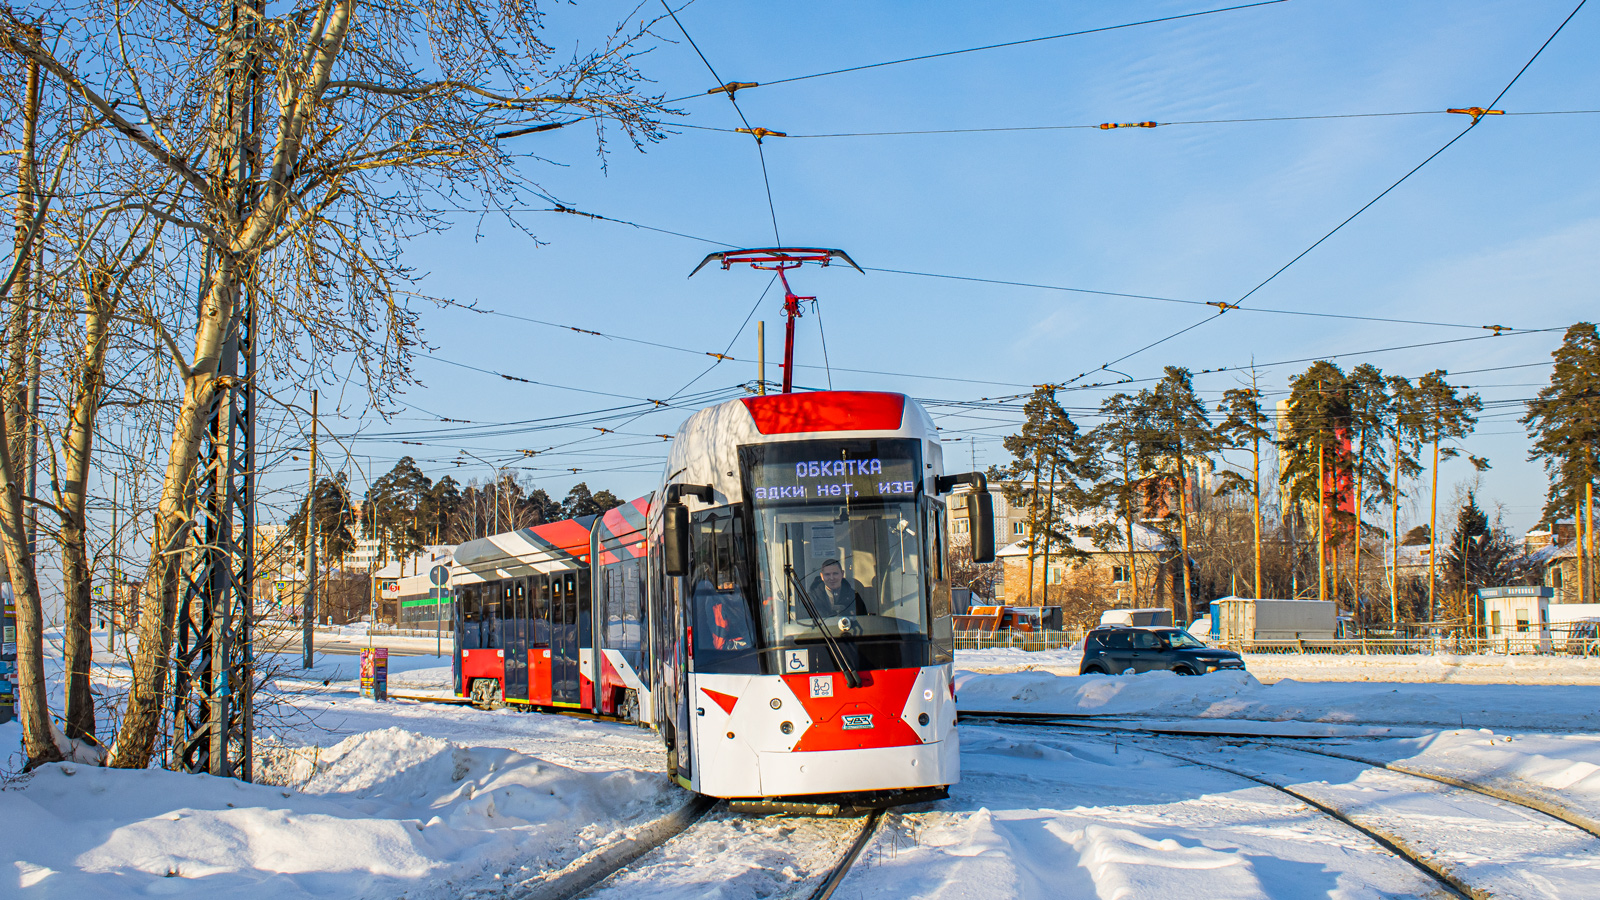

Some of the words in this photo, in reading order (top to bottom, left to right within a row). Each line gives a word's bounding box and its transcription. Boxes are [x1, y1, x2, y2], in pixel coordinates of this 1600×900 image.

[796, 459, 882, 478] ОБКАТКА
[755, 485, 805, 500] адки
[817, 483, 859, 498] нет,
